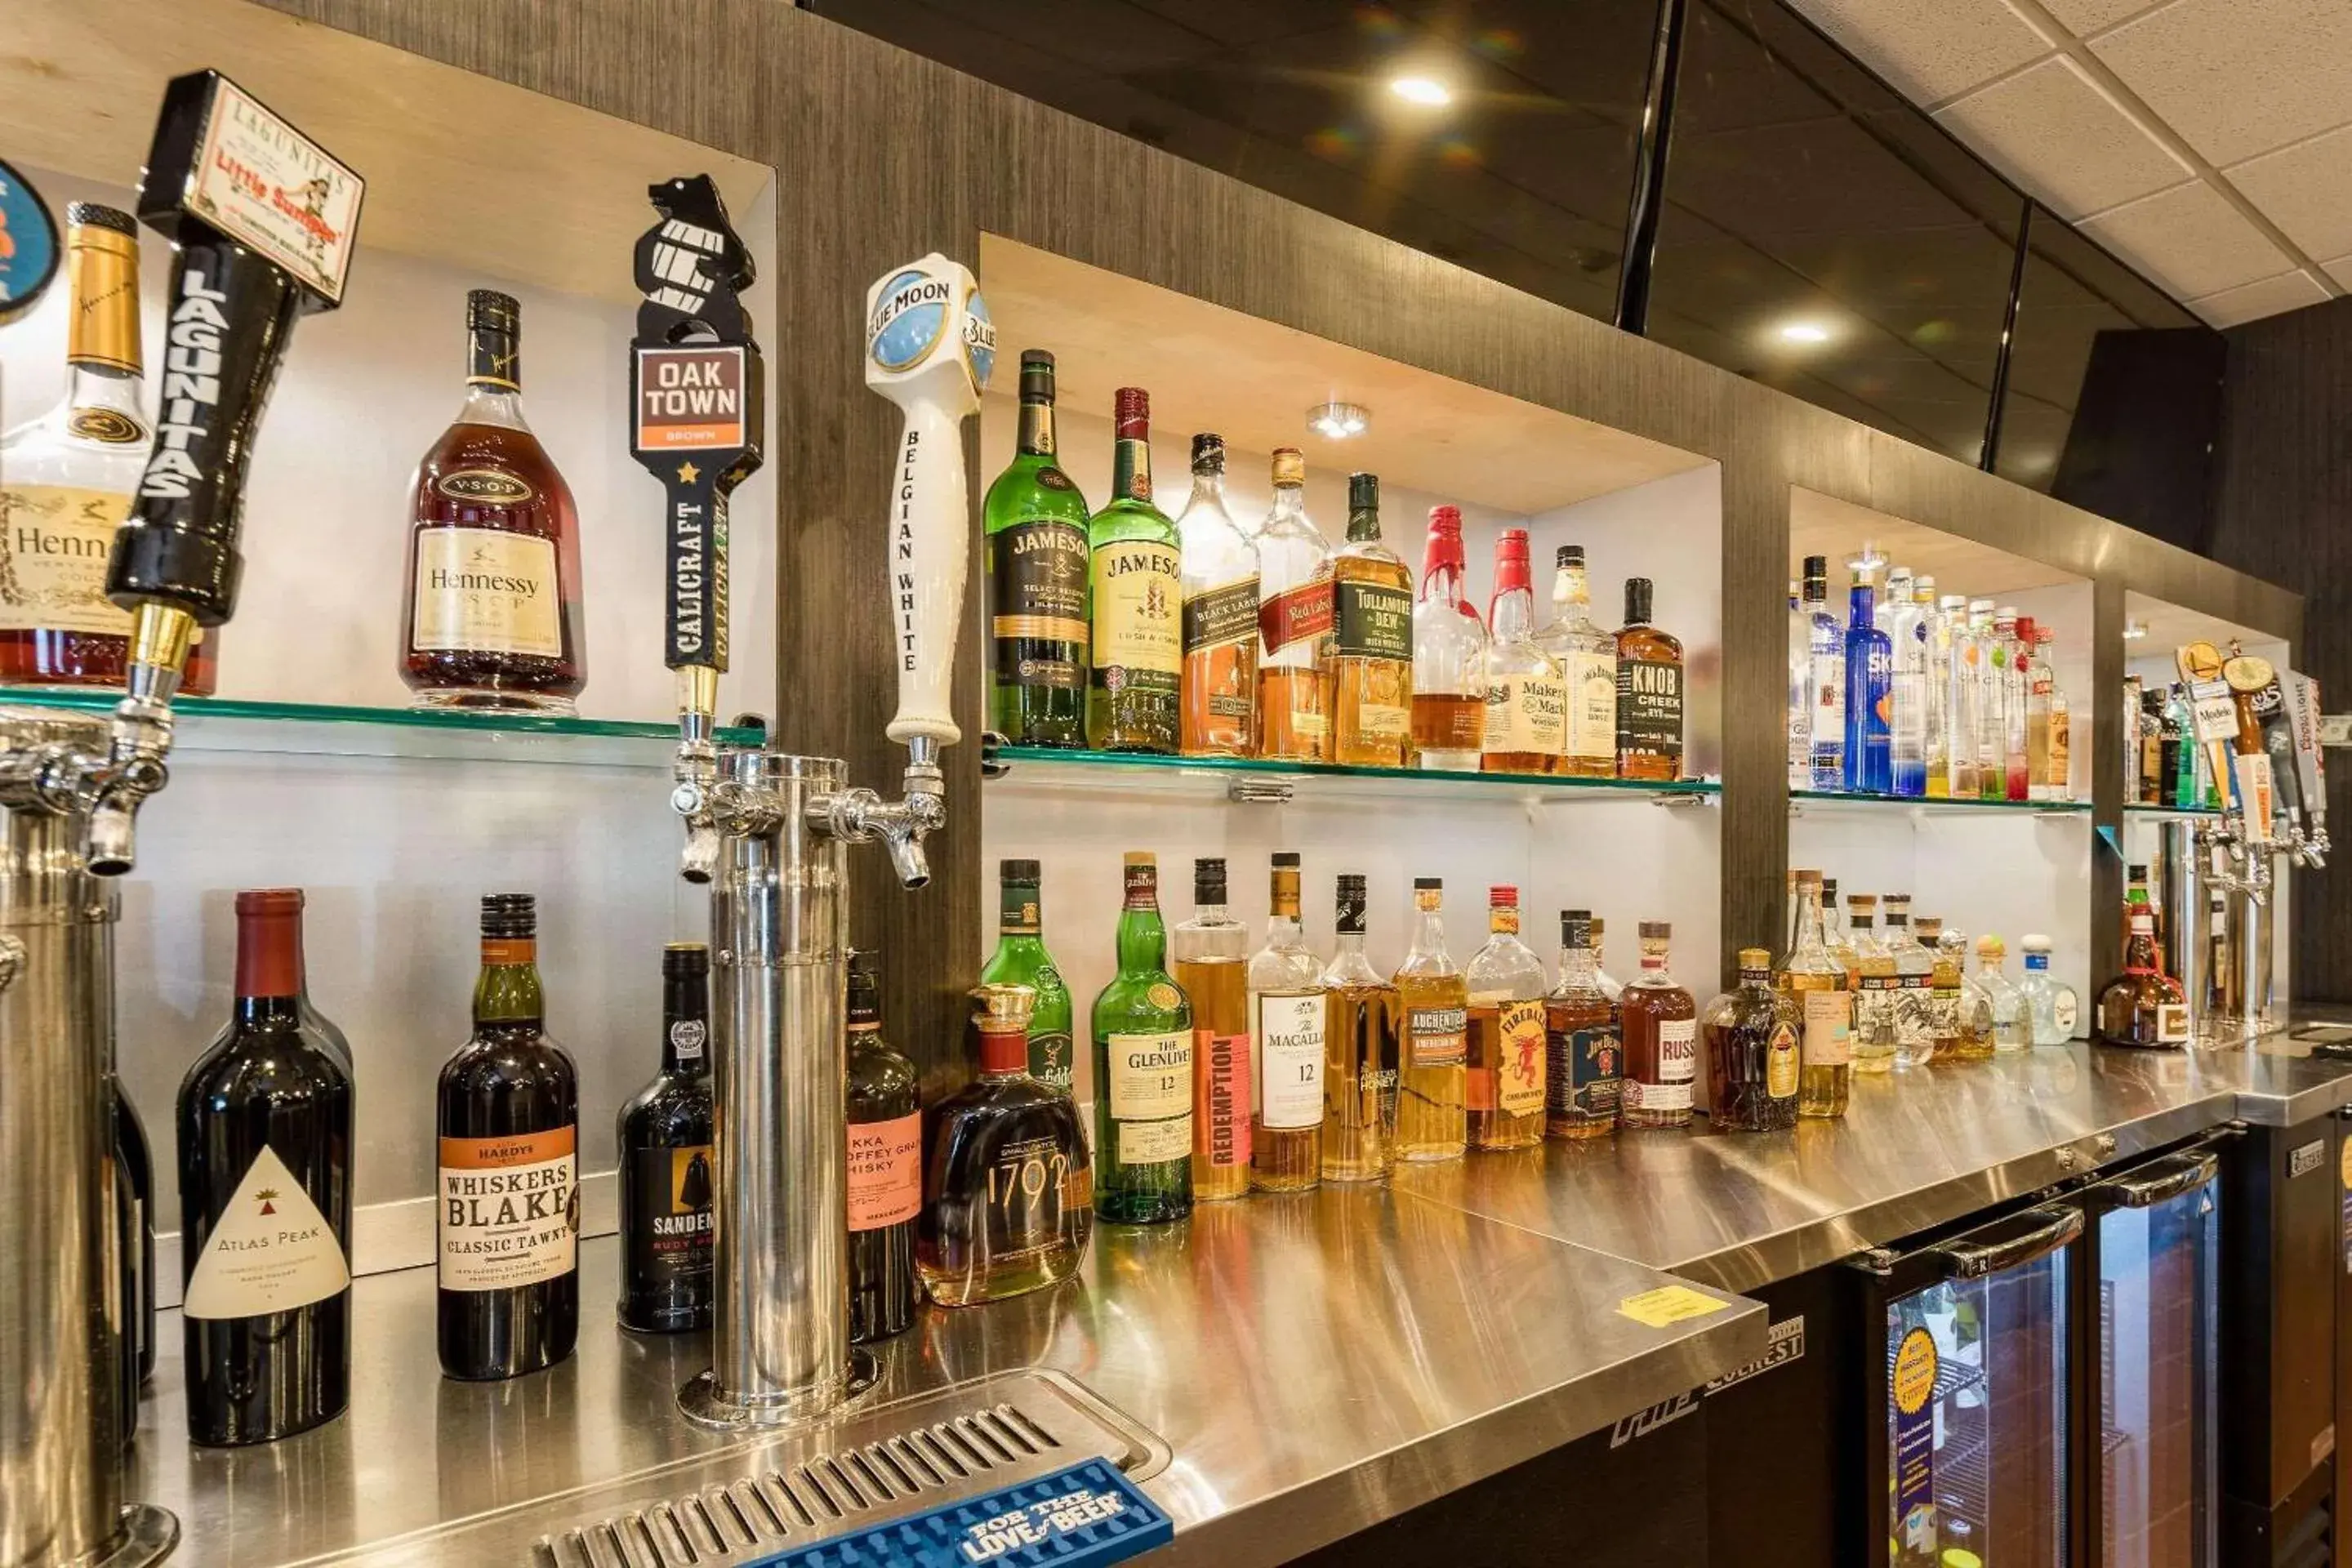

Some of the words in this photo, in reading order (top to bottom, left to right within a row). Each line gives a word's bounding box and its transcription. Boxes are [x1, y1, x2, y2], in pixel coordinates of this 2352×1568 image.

[894, 283, 950, 314] MOON
[142, 270, 230, 499] LAGUNITAS
[658, 362, 722, 388] OAK
[645, 388, 737, 416] TOWN
[666, 430, 715, 442] BROWN
[899, 430, 920, 559] BELGIAN
[17, 527, 106, 559] Henn
[1013, 531, 1089, 564] JAMESON
[676, 501, 702, 653] CALICRAFT
[1107, 554, 1181, 580] JAMESO
[430, 568, 539, 599] Hennessy
[1356, 588, 1411, 616] TULLAMORE
[898, 573, 916, 672] WHITE
[1633, 664, 1676, 696] KNOB
[1637, 695, 1682, 710] CREEK
[1156, 1040, 1178, 1053] THE
[1662, 1039, 1695, 1061] RUSS
[1160, 1076, 1175, 1091] 12
[1299, 1063, 1315, 1082] 12
[1360, 1075, 1398, 1092] HONEY
[1212, 1039, 1233, 1165] REDEMPTION
[852, 1136, 883, 1147] KKA
[447, 1164, 568, 1196] WHISKERS
[849, 1160, 893, 1174] HISKY
[989, 1153, 1067, 1211] 1792
[448, 1185, 568, 1227] BLAKE
[217, 1236, 270, 1252] ATLAS
[278, 1227, 321, 1245] PEAK
[448, 1239, 510, 1254] CLASSIC
[517, 1226, 568, 1249] TAWNY
[962, 1521, 1041, 1562] LOVE
[1049, 1494, 1125, 1532] BEER
[969, 1509, 1029, 1539] FOR
[1029, 1490, 1092, 1516] THE
